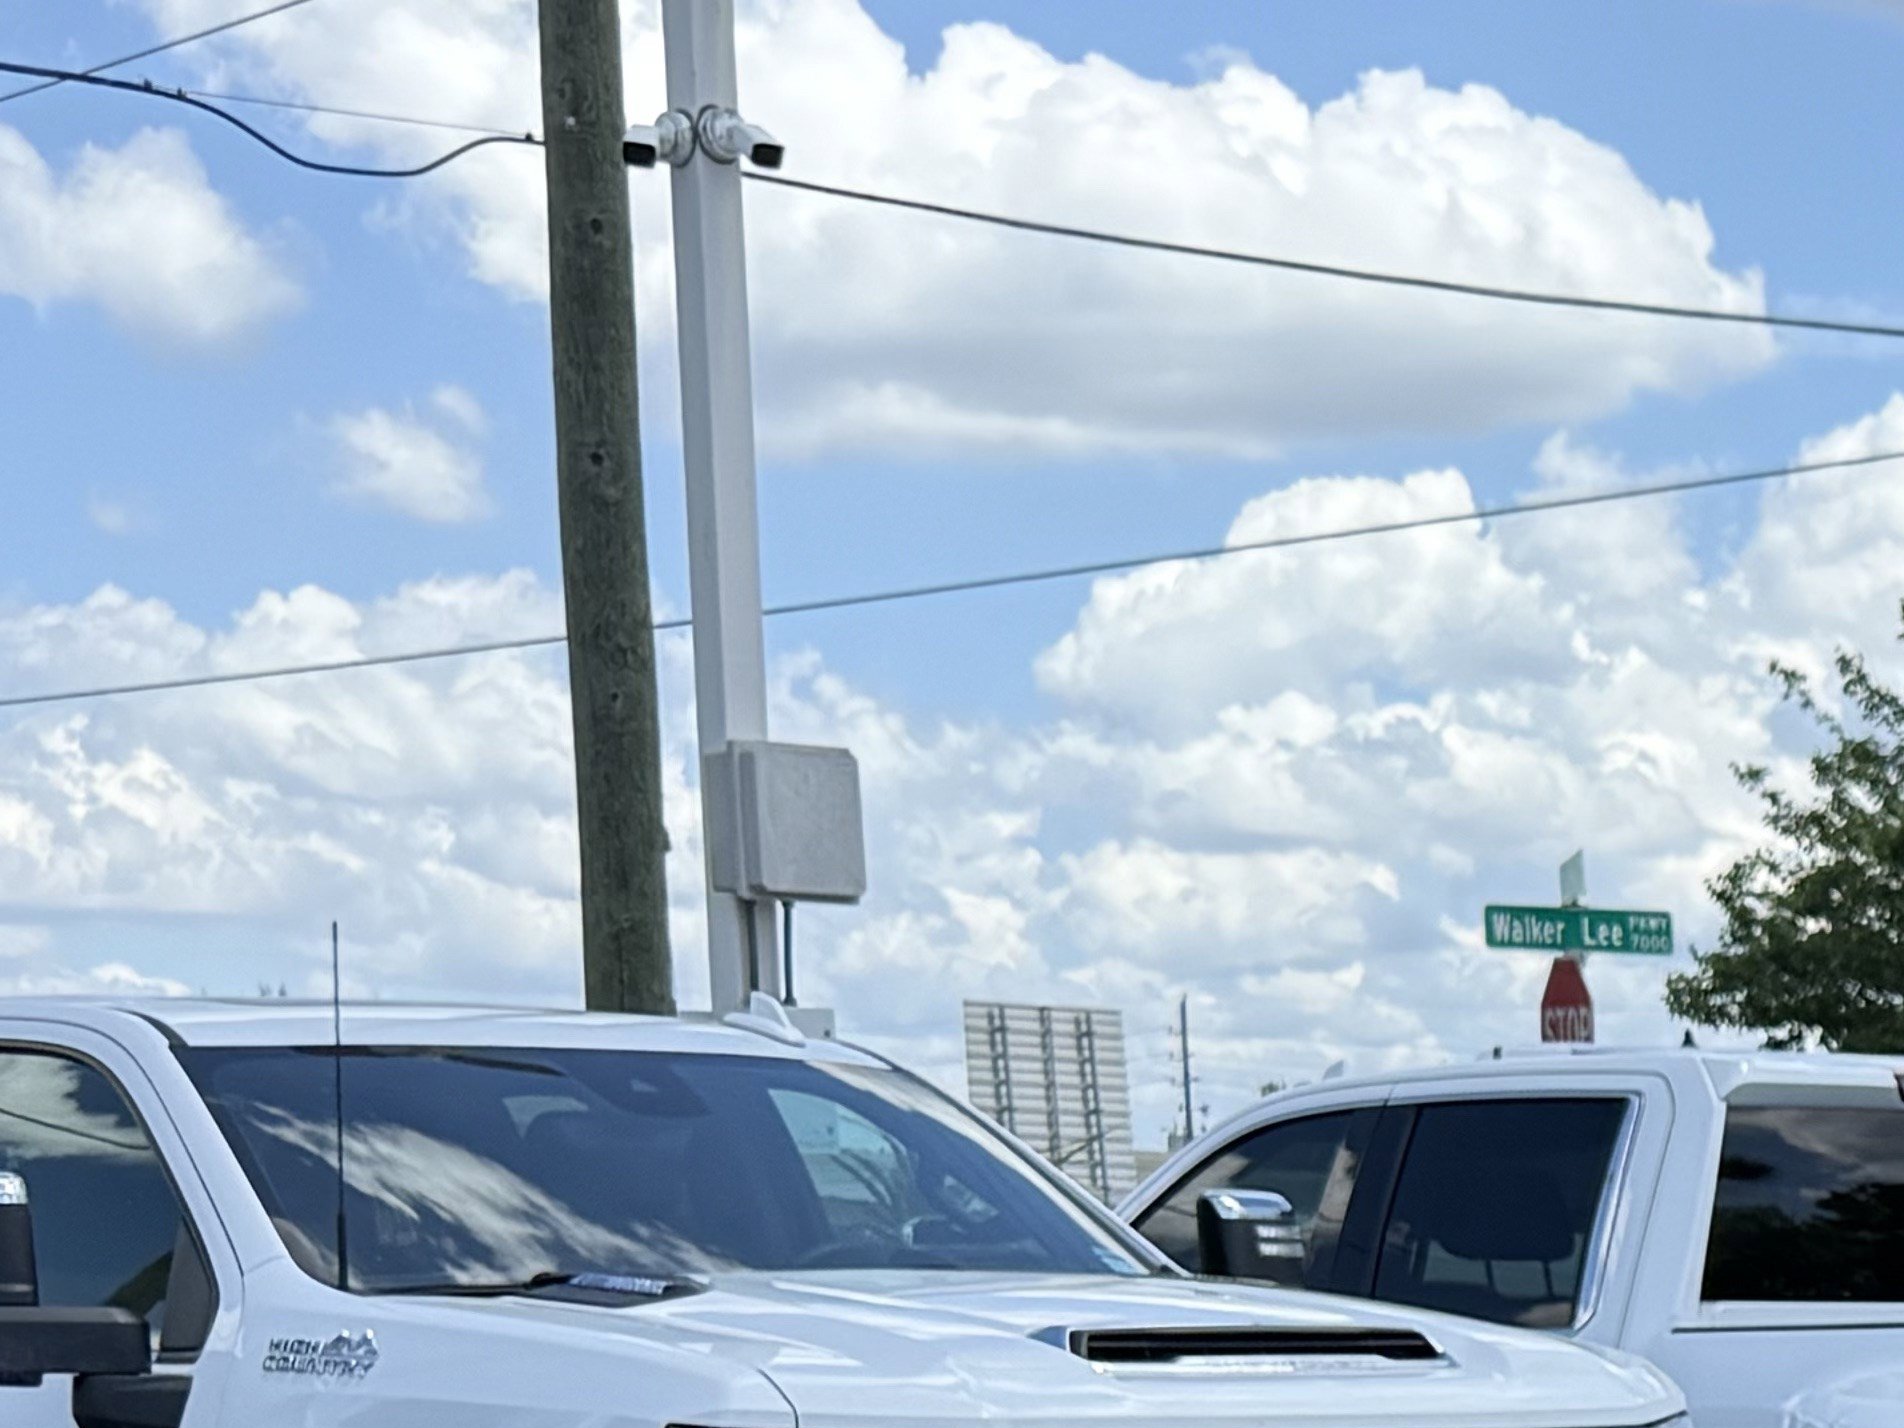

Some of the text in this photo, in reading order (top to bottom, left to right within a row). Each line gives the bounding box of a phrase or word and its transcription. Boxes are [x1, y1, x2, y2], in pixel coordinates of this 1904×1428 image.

[1493, 914, 1623, 946] Walker Lee
[1544, 1007, 1593, 1041] STOP
